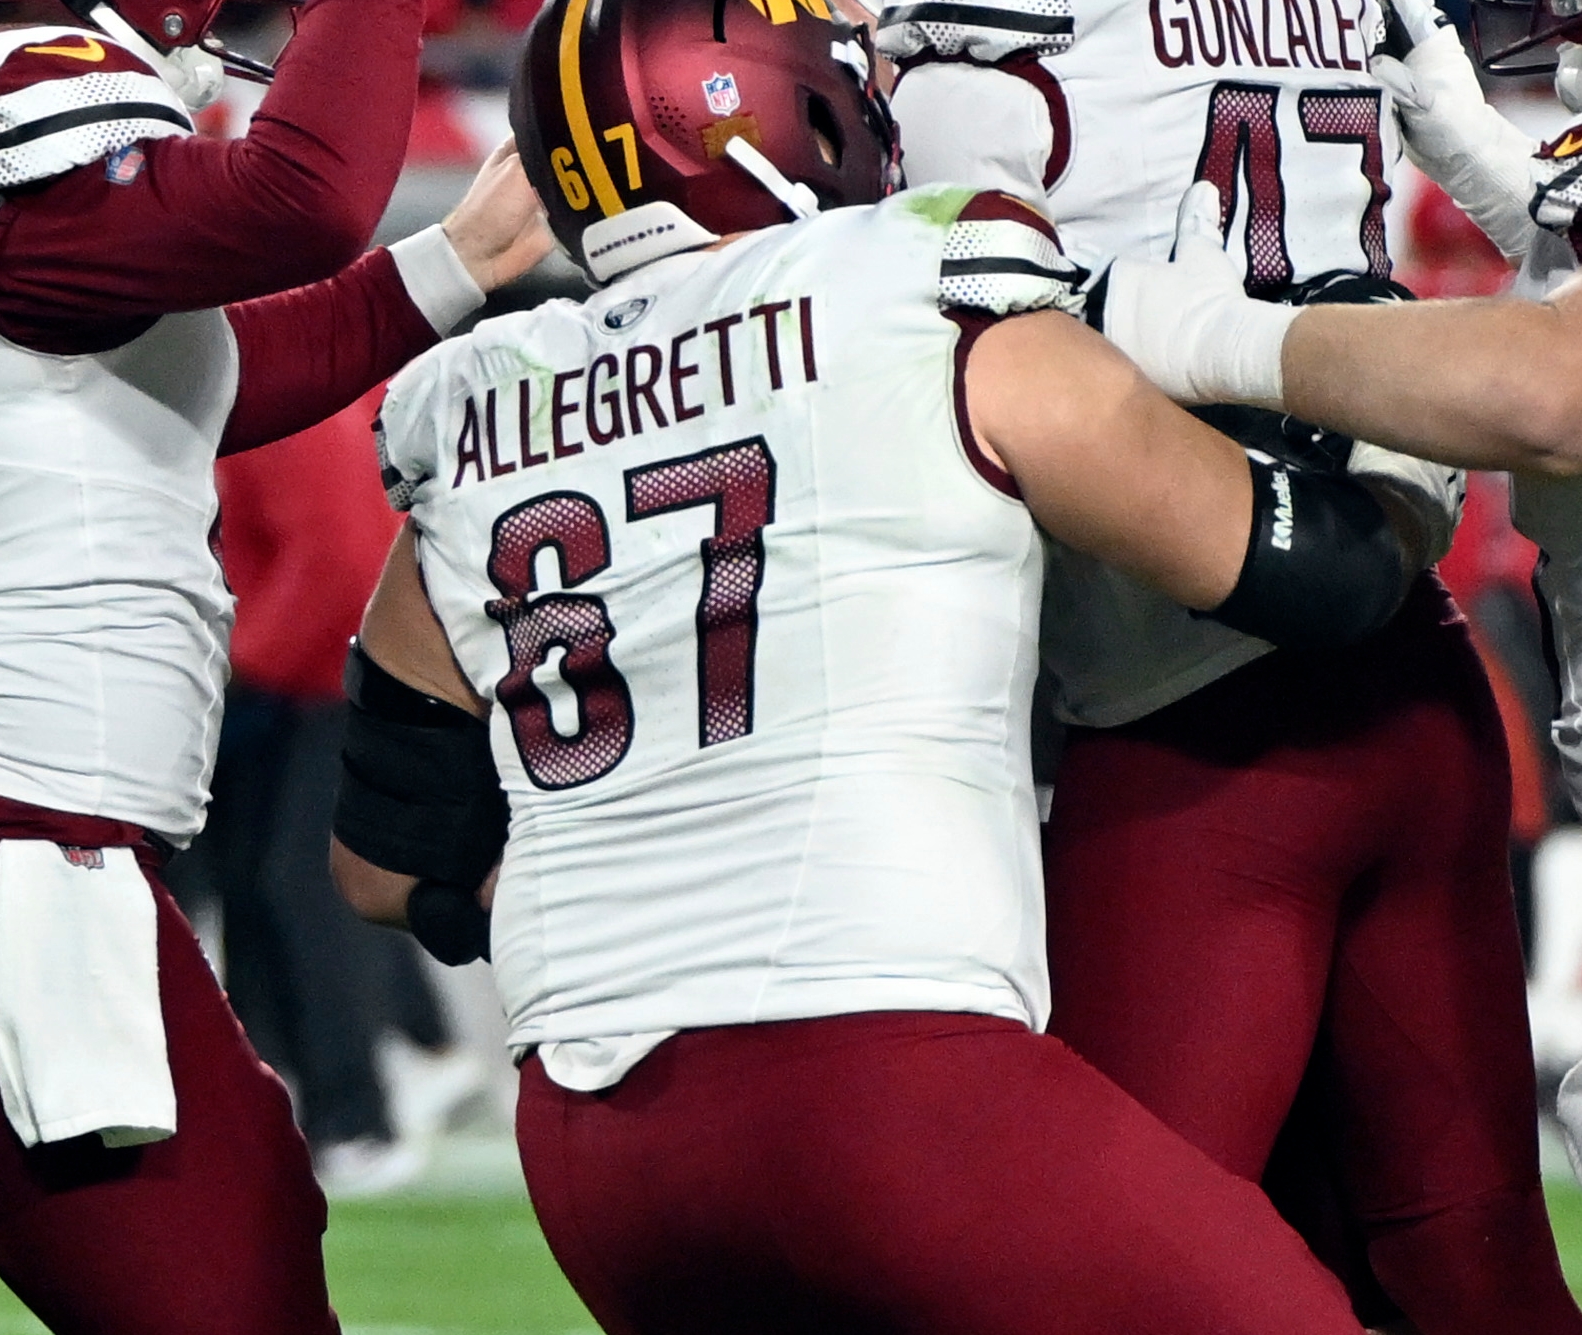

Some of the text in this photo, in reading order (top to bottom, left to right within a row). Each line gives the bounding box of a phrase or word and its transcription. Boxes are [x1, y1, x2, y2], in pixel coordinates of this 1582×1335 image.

[1168, 79, 1396, 300] 47
[451, 296, 819, 490] ALLEGRETTI
[483, 433, 779, 792] 67
